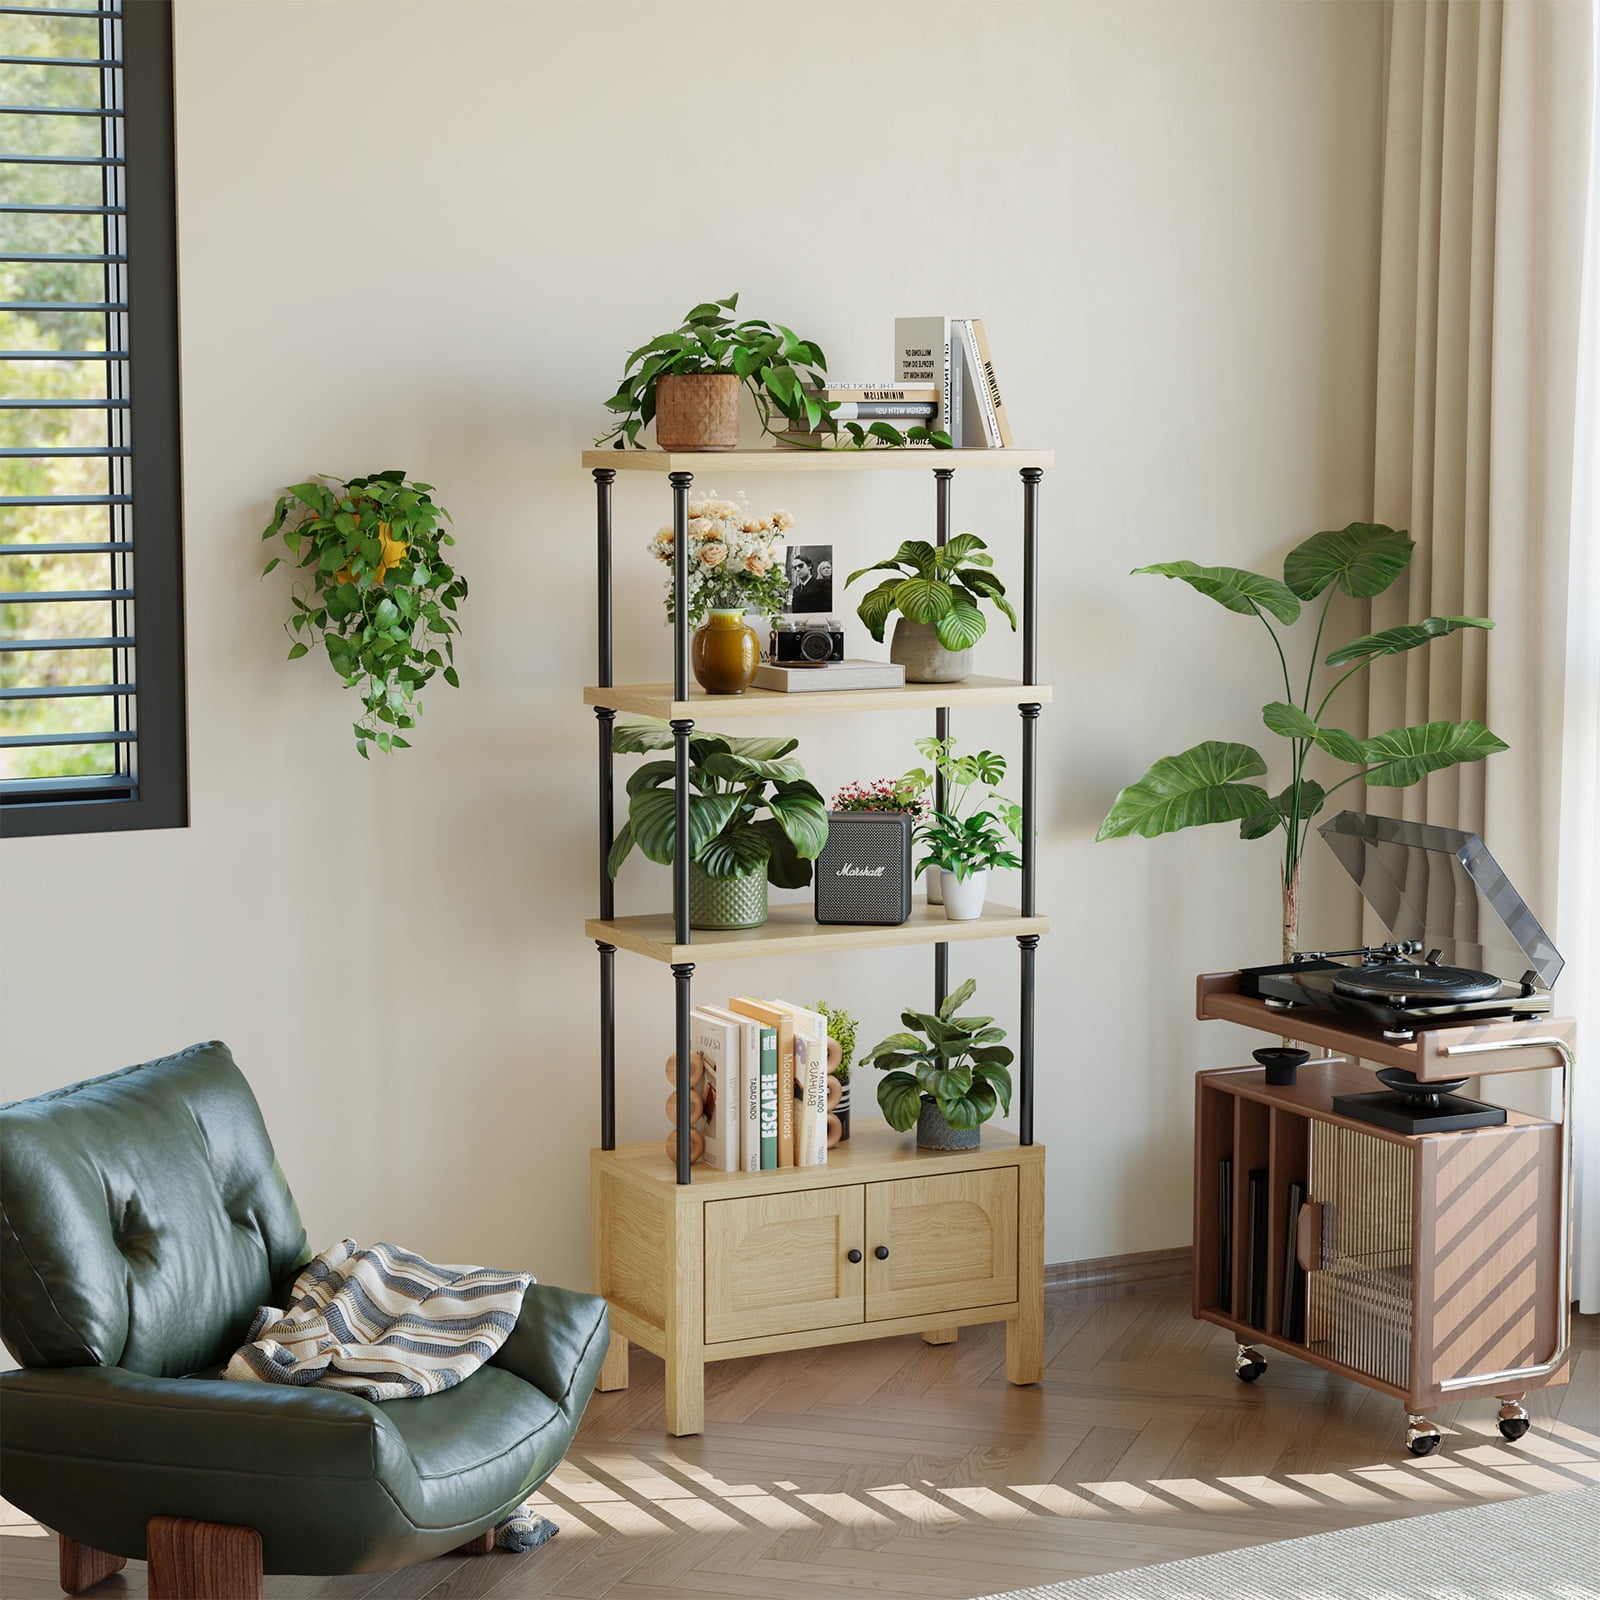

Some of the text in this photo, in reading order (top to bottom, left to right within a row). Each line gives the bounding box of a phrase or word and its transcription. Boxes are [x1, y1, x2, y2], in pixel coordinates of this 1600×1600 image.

[836, 862, 885, 877] Marshall
[749, 1077, 757, 1120] TADAO ANDO
[761, 1073, 778, 1138] ESCAPEE
[817, 1095, 825, 1113] ANDO
